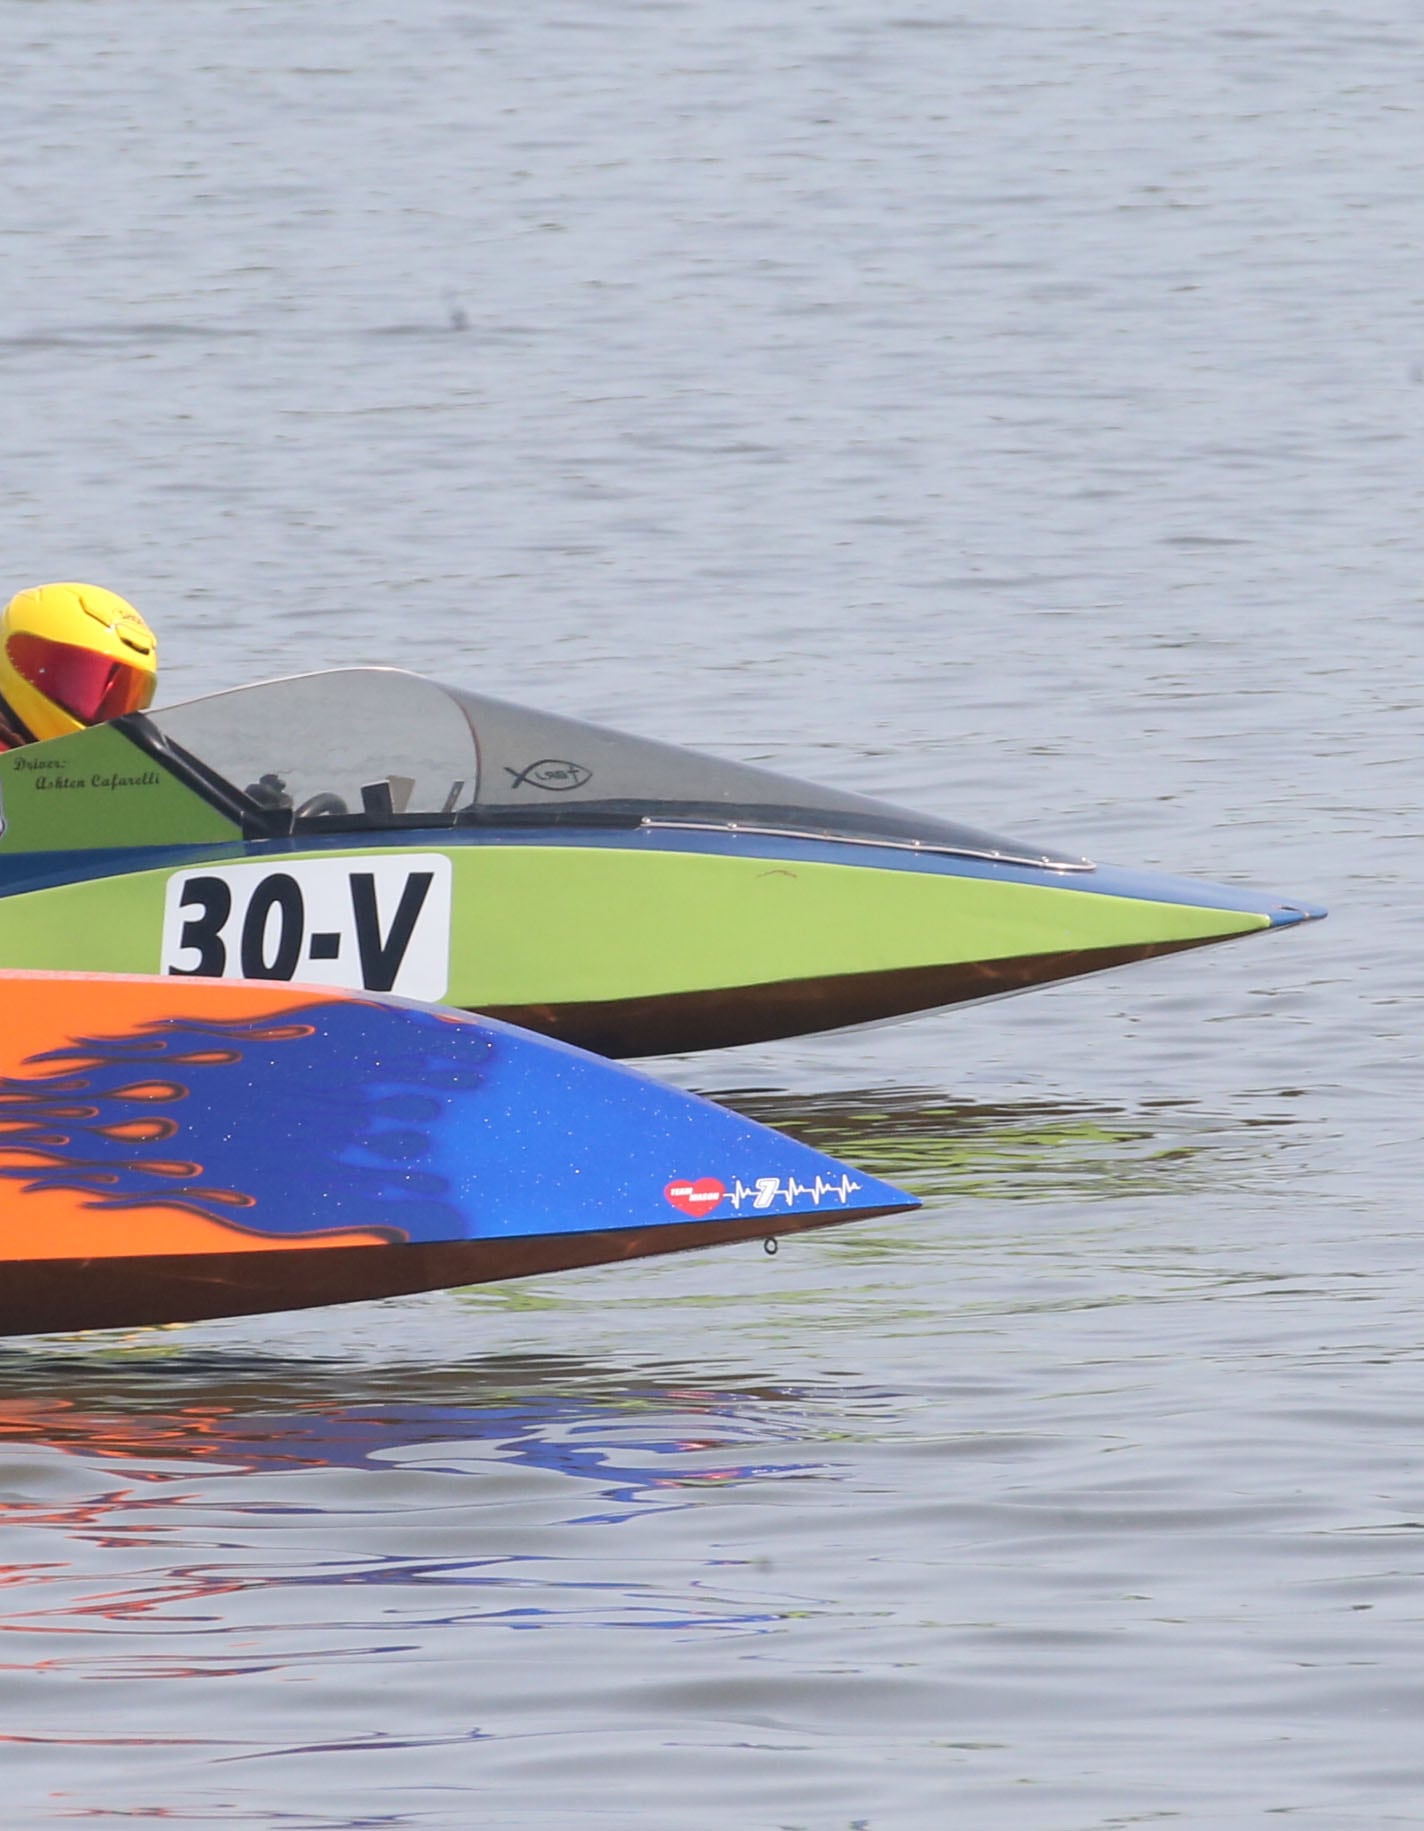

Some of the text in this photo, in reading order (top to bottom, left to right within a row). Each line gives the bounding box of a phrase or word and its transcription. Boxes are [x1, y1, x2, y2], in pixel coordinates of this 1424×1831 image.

[13, 757, 66, 771] Driver:
[91, 772, 160, 791] Cafarelli
[168, 871, 434, 993] 30-V
